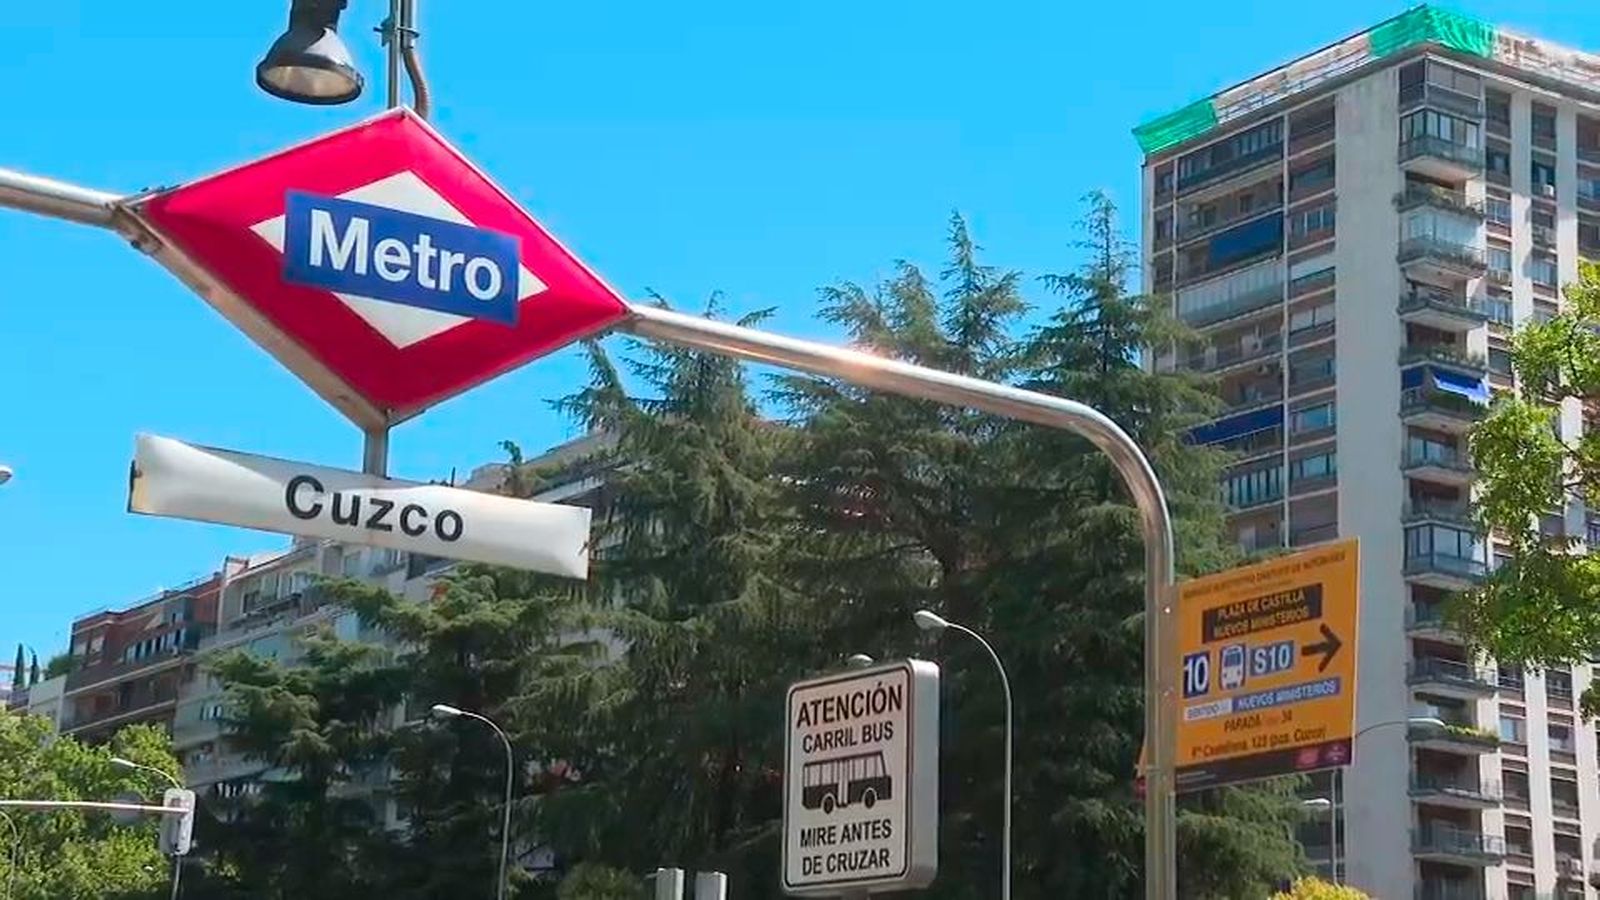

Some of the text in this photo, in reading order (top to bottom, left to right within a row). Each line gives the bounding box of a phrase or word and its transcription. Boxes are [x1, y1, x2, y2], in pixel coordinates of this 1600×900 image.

[309, 209, 501, 300] Metro
[284, 474, 464, 542] Cuzco
[1217, 590, 1305, 618] PLAZA DE CASTILLA
[1213, 606, 1309, 638] NUEVOS MINISTERIOS
[1183, 644, 1291, 693] 10 S10
[797, 682, 902, 728] ATENCIÓN
[1238, 692, 1274, 710] NUEVOS
[1276, 680, 1336, 703] MINISTERIOS
[803, 721, 894, 753] CARRIL BUS
[1224, 714, 1261, 733] PARADA
[800, 819, 892, 848] MIRE ANTES
[802, 848, 890, 876] DE CRUZAR
